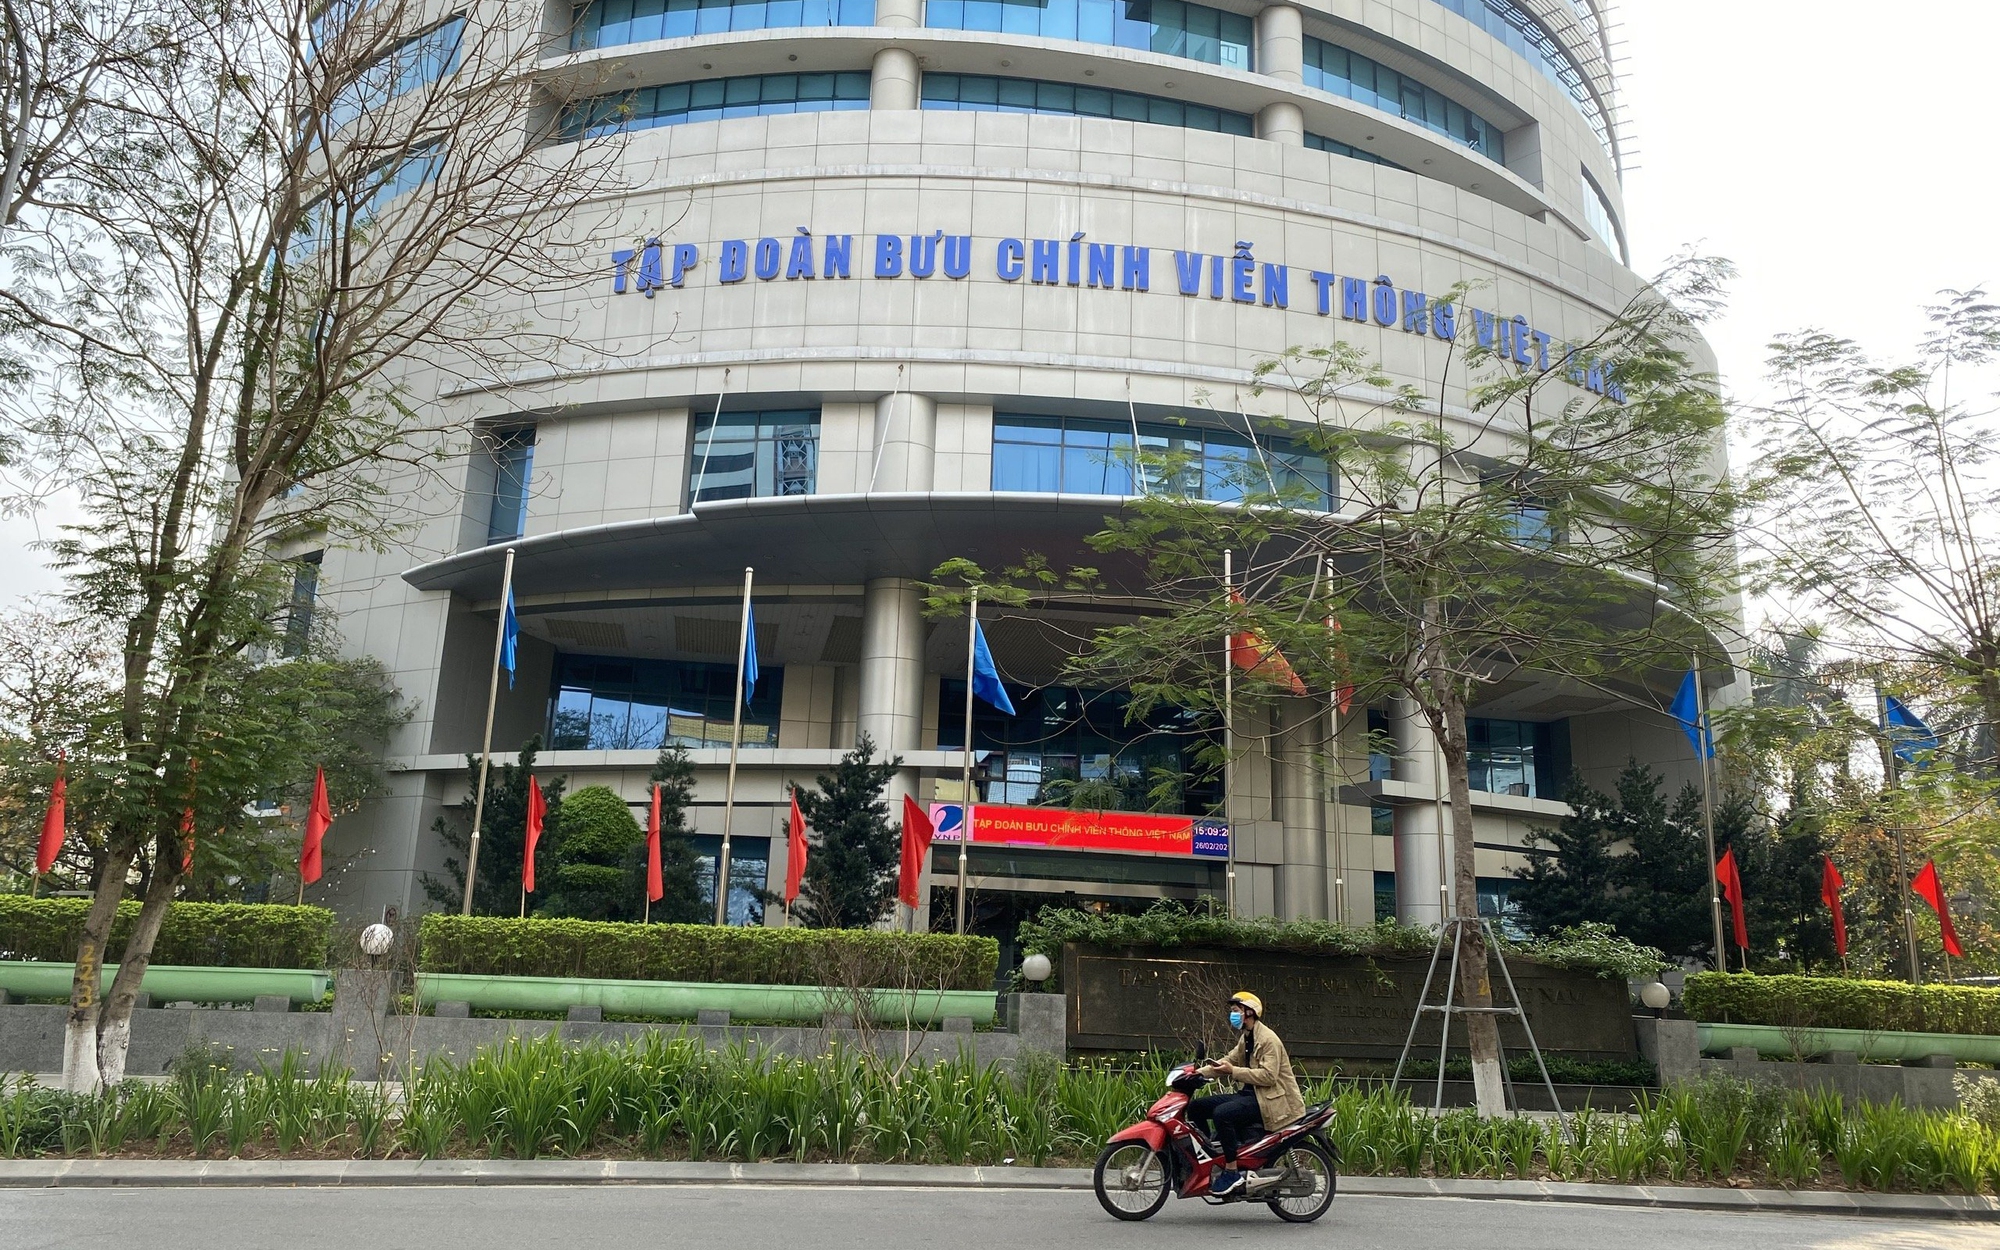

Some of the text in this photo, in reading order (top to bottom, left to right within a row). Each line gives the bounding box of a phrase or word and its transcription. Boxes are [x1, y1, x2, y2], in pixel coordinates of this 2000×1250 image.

[612, 237, 698, 299] TẬP
[719, 227, 852, 283] ĐOÀN
[874, 229, 972, 280] BƯU
[996, 232, 1149, 292] CHÍNH
[1173, 241, 1289, 309] VIỄN
[1310, 273, 1455, 341] THÔNG
[1471, 308, 1551, 373] VIỆT
[974, 818, 993, 830] TẬP
[995, 819, 1024, 831] ĐOÀN
[1026, 822, 1048, 832] BƯU
[1050, 822, 1082, 834] CHÍNH
[1109, 826, 1143, 837] THÔNG
[1169, 831, 1191, 841] NAM
